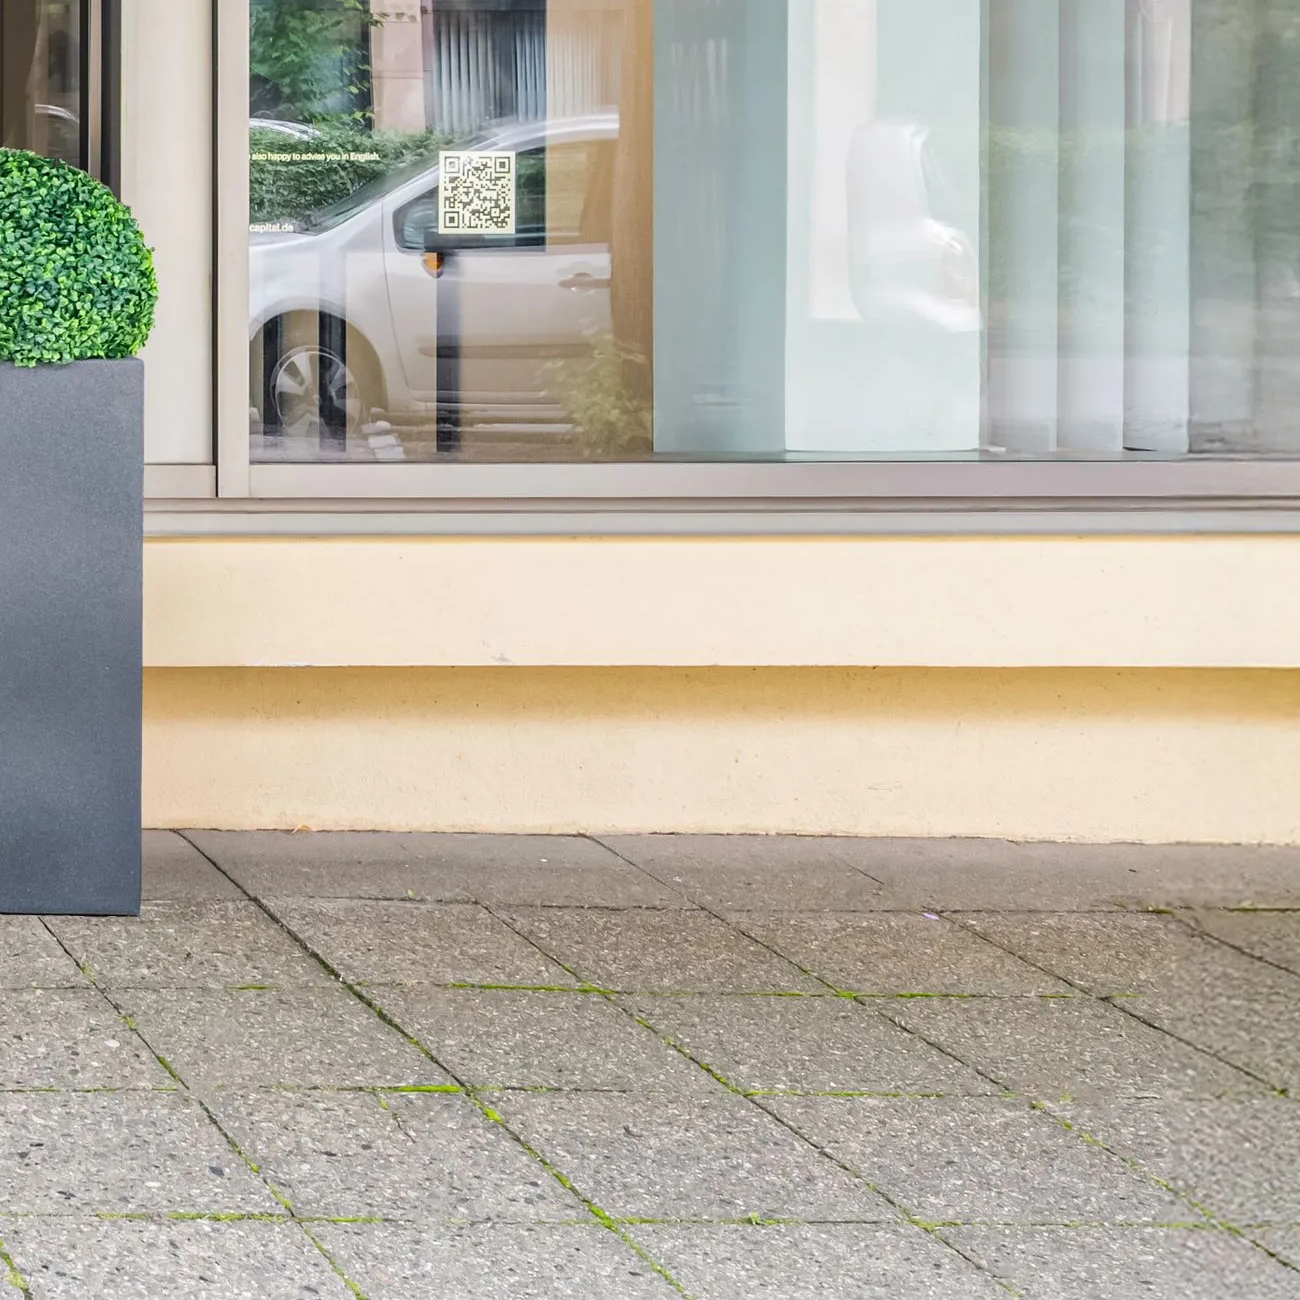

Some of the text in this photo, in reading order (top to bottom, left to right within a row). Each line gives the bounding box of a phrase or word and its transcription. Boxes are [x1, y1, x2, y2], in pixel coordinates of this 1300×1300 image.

[251, 152, 267, 161] also
[268, 152, 291, 162] happy
[326, 153, 340, 162] you
[341, 152, 349, 160] in
[350, 152, 381, 163] English.
[248, 223, 294, 233] capital.de
